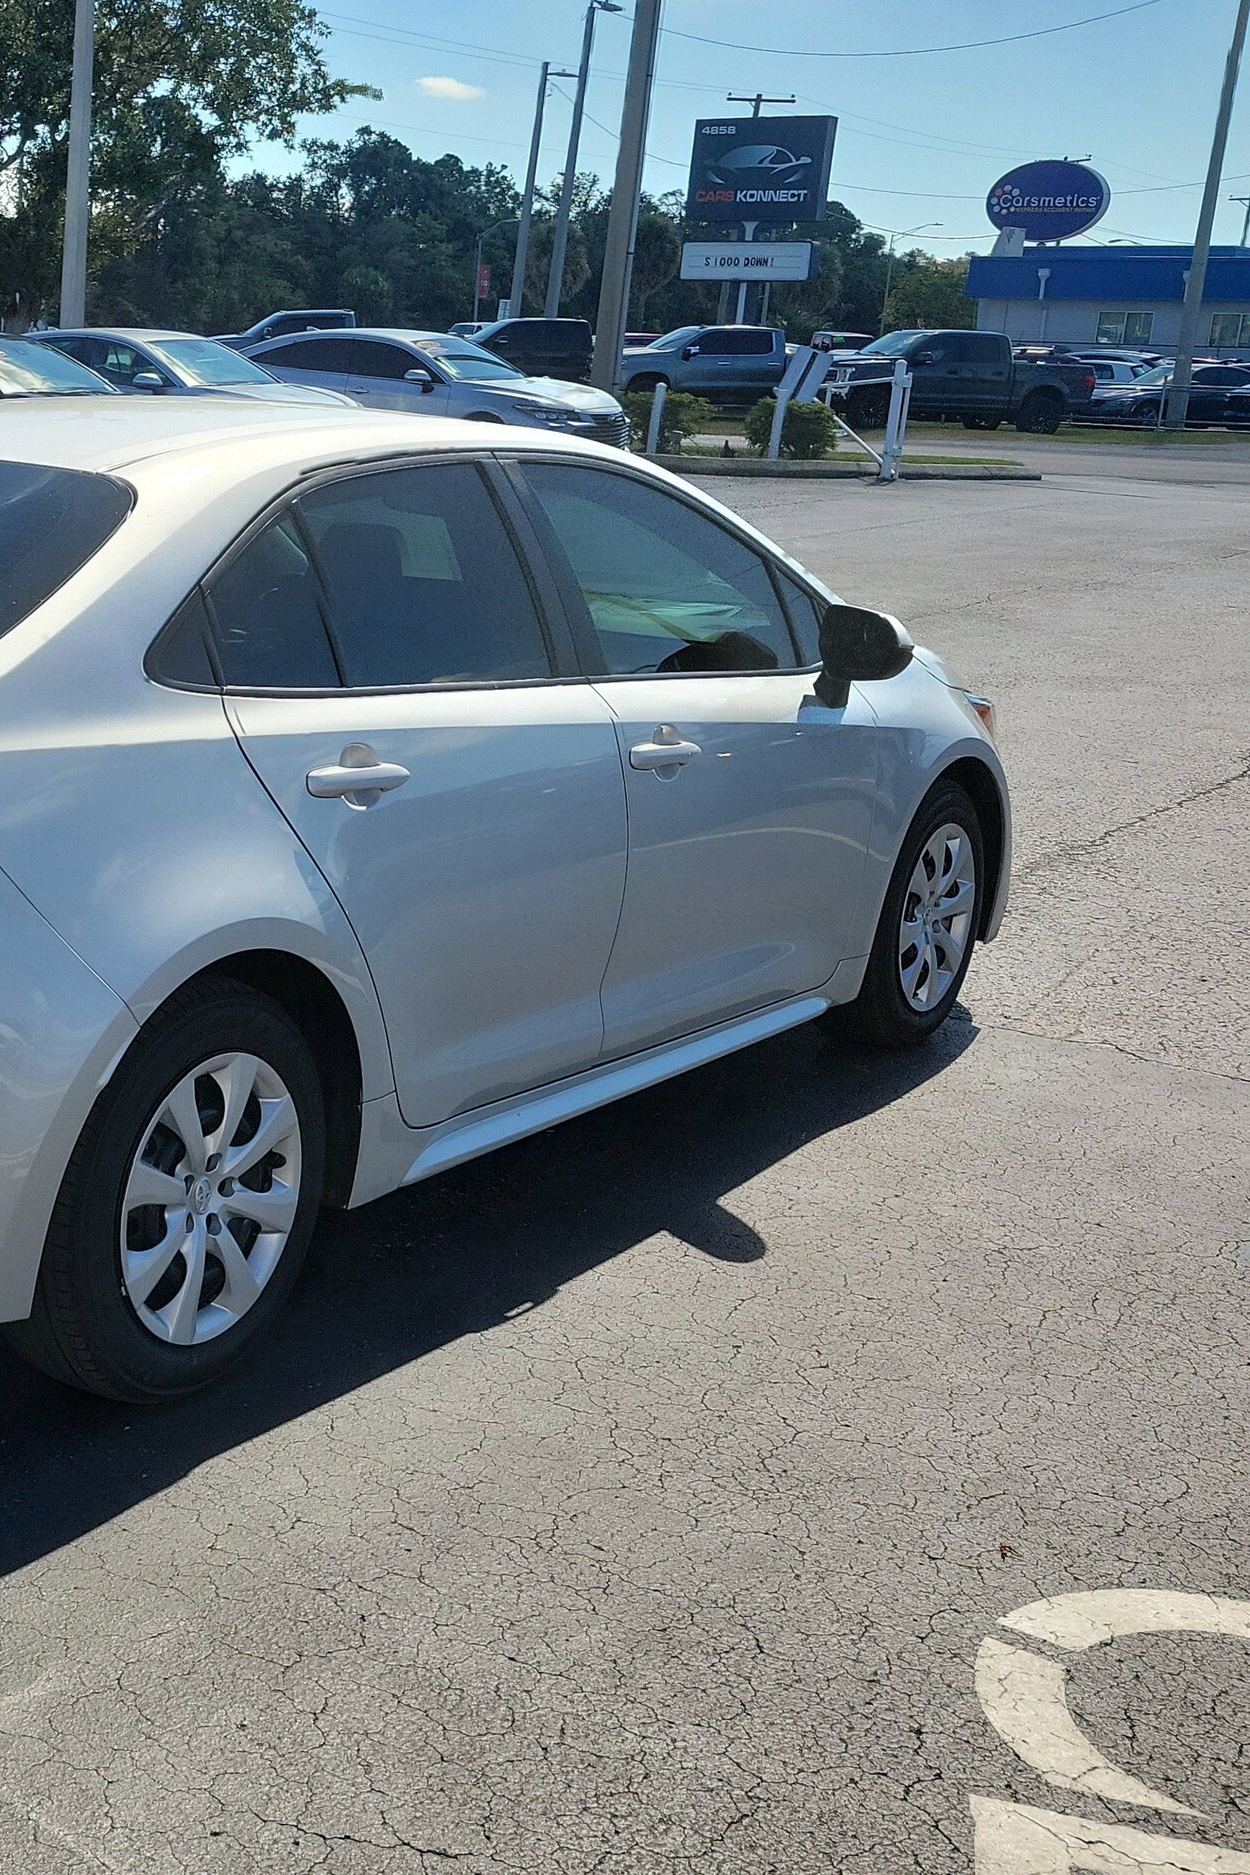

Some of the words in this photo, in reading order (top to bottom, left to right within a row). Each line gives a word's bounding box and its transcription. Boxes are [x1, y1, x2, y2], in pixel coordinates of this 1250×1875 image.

[701, 126, 736, 135] 4858
[696, 190, 734, 202] CARS
[735, 189, 808, 202] KONNECT
[1000, 194, 1097, 208] Carsmetics
[743, 256, 774, 267] DOWN!
